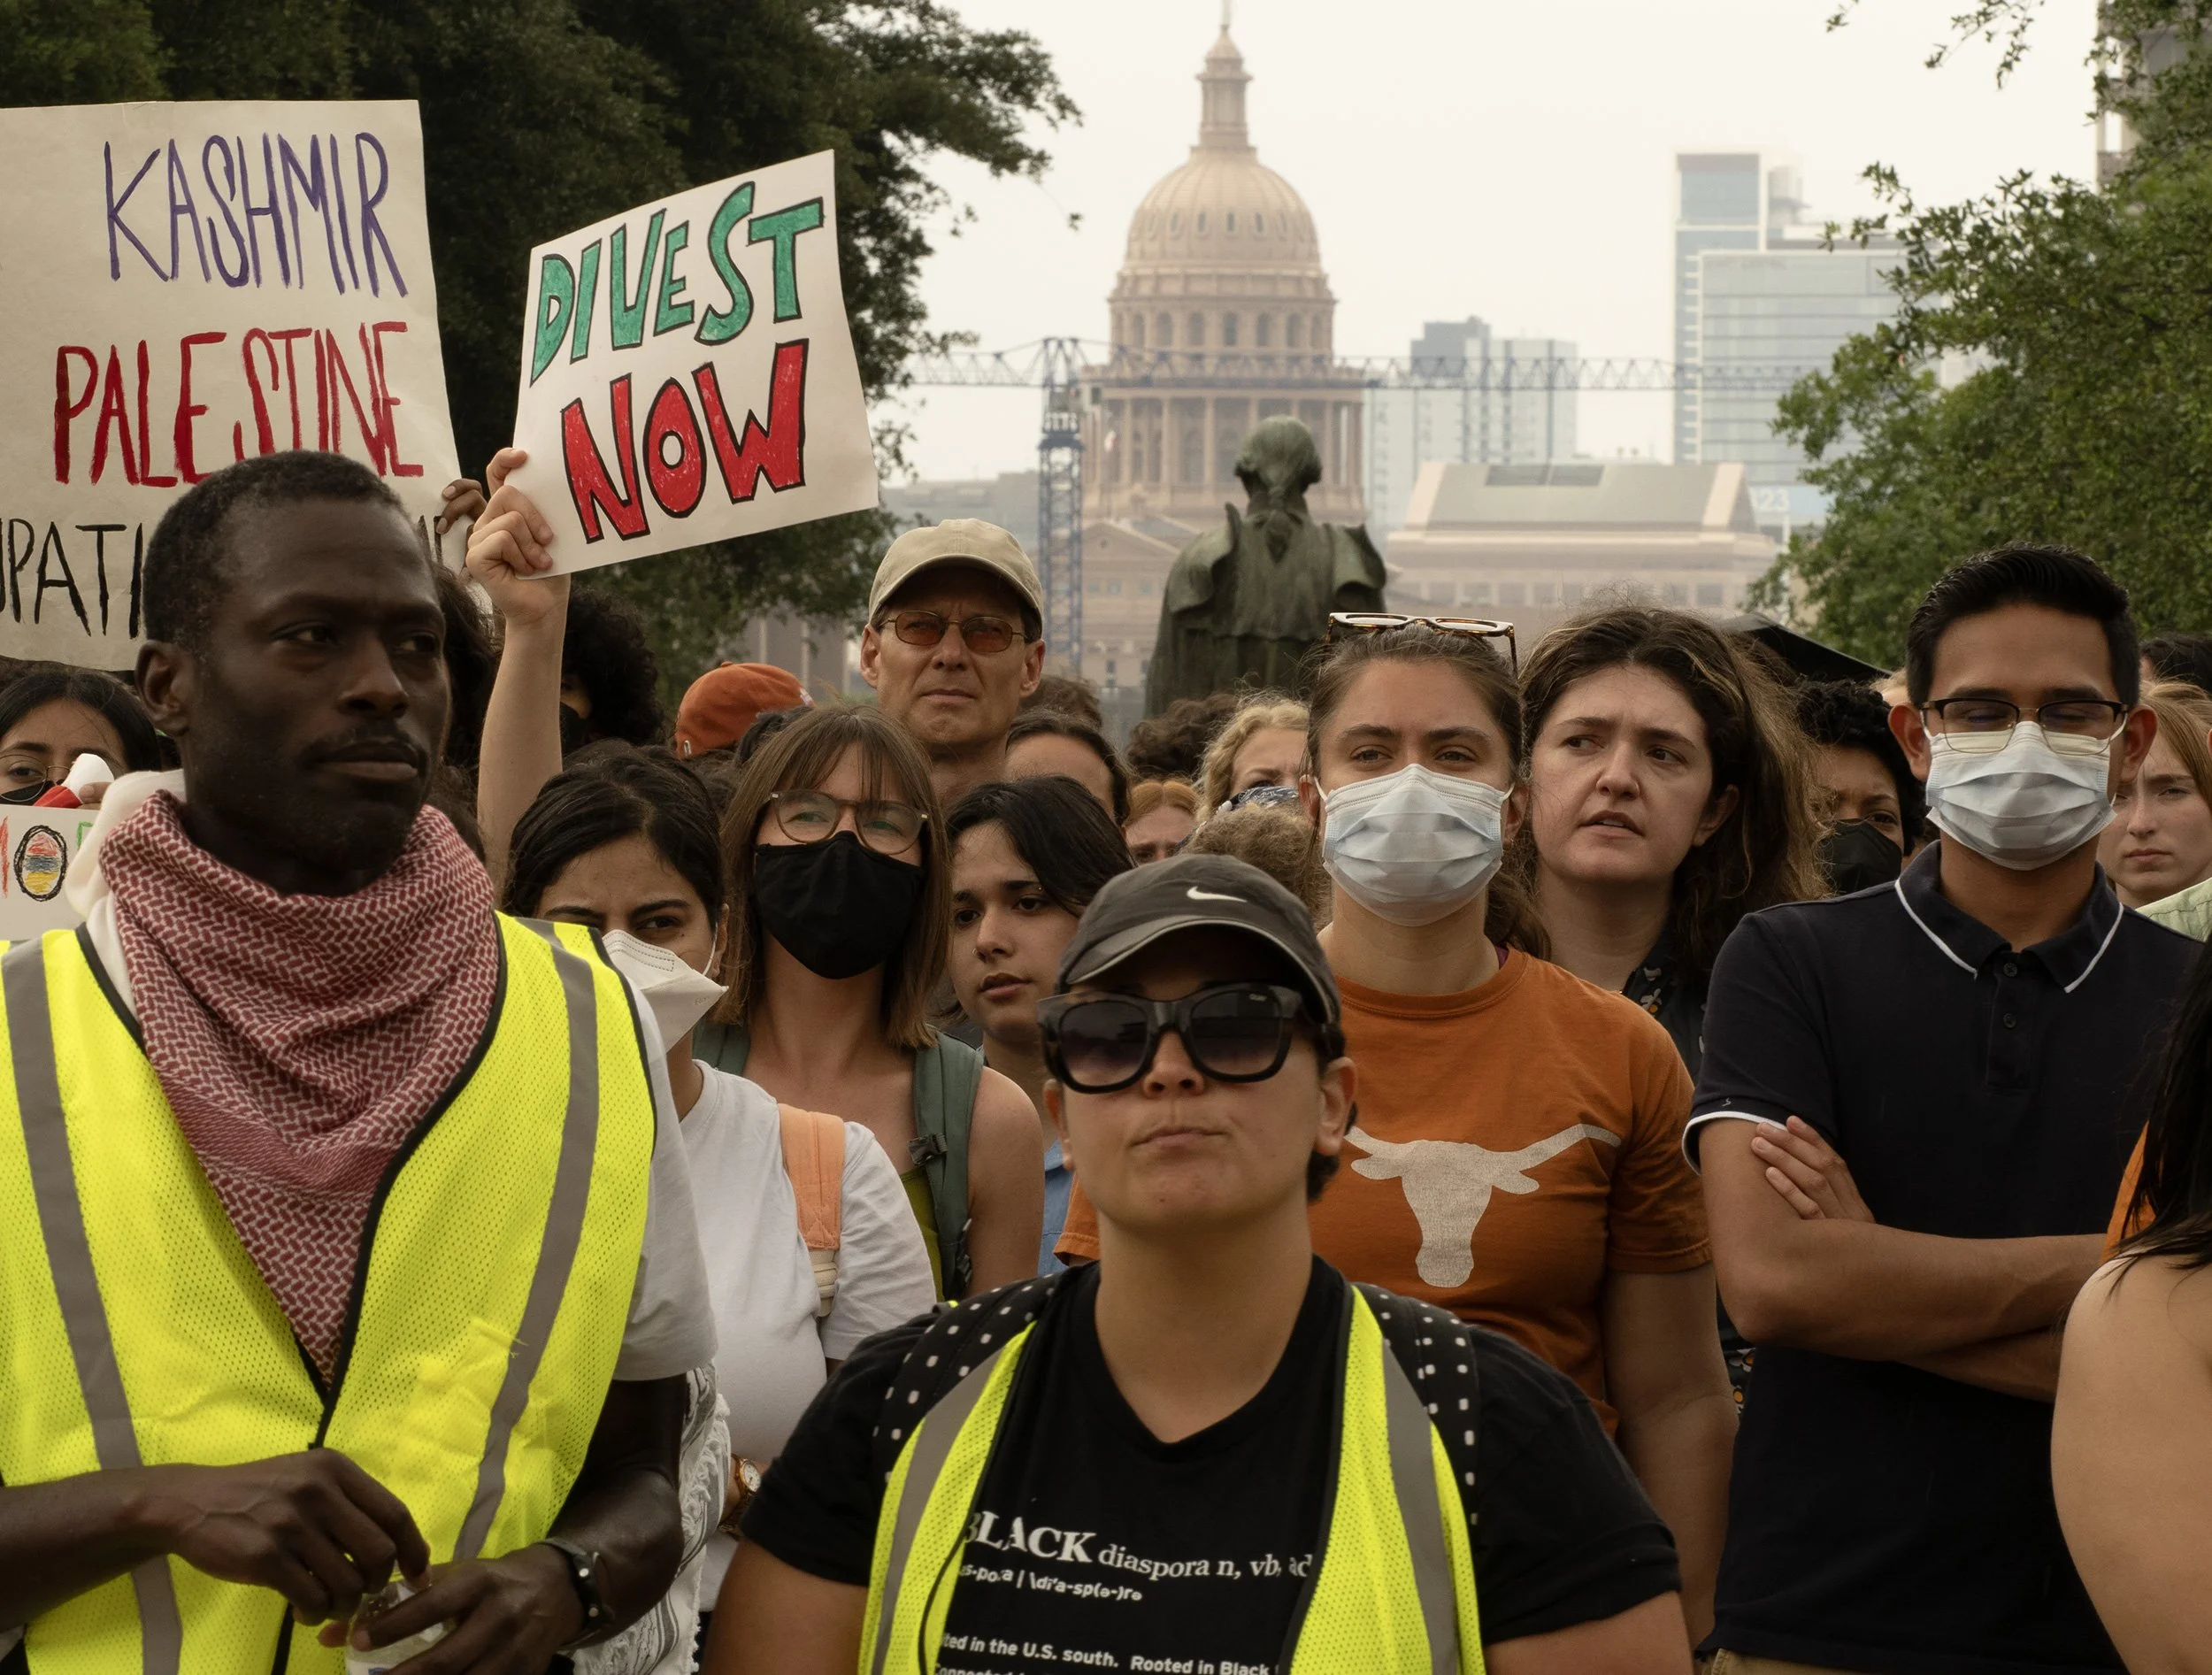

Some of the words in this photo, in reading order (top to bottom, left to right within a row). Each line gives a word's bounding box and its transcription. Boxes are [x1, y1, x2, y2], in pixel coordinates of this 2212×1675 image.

[104, 132, 409, 297] KASHMIR
[529, 181, 826, 388] DIVEST
[53, 321, 424, 487] PALESTINE
[560, 338, 809, 544] NOW
[0, 518, 142, 640] PATI
[1097, 1543, 1210, 1581] diaspora
[1216, 1559, 1241, 1579] n,
[941, 1633, 968, 1650] ted
[970, 1637, 986, 1652] in
[989, 1639, 1018, 1656] the
[1022, 1642, 1057, 1660] U.S.
[1063, 1649, 1119, 1668] south.
[1130, 1656, 1194, 1674] Rooted
[1197, 1660, 1215, 1675] in
[1219, 1661, 1270, 1675] Black
